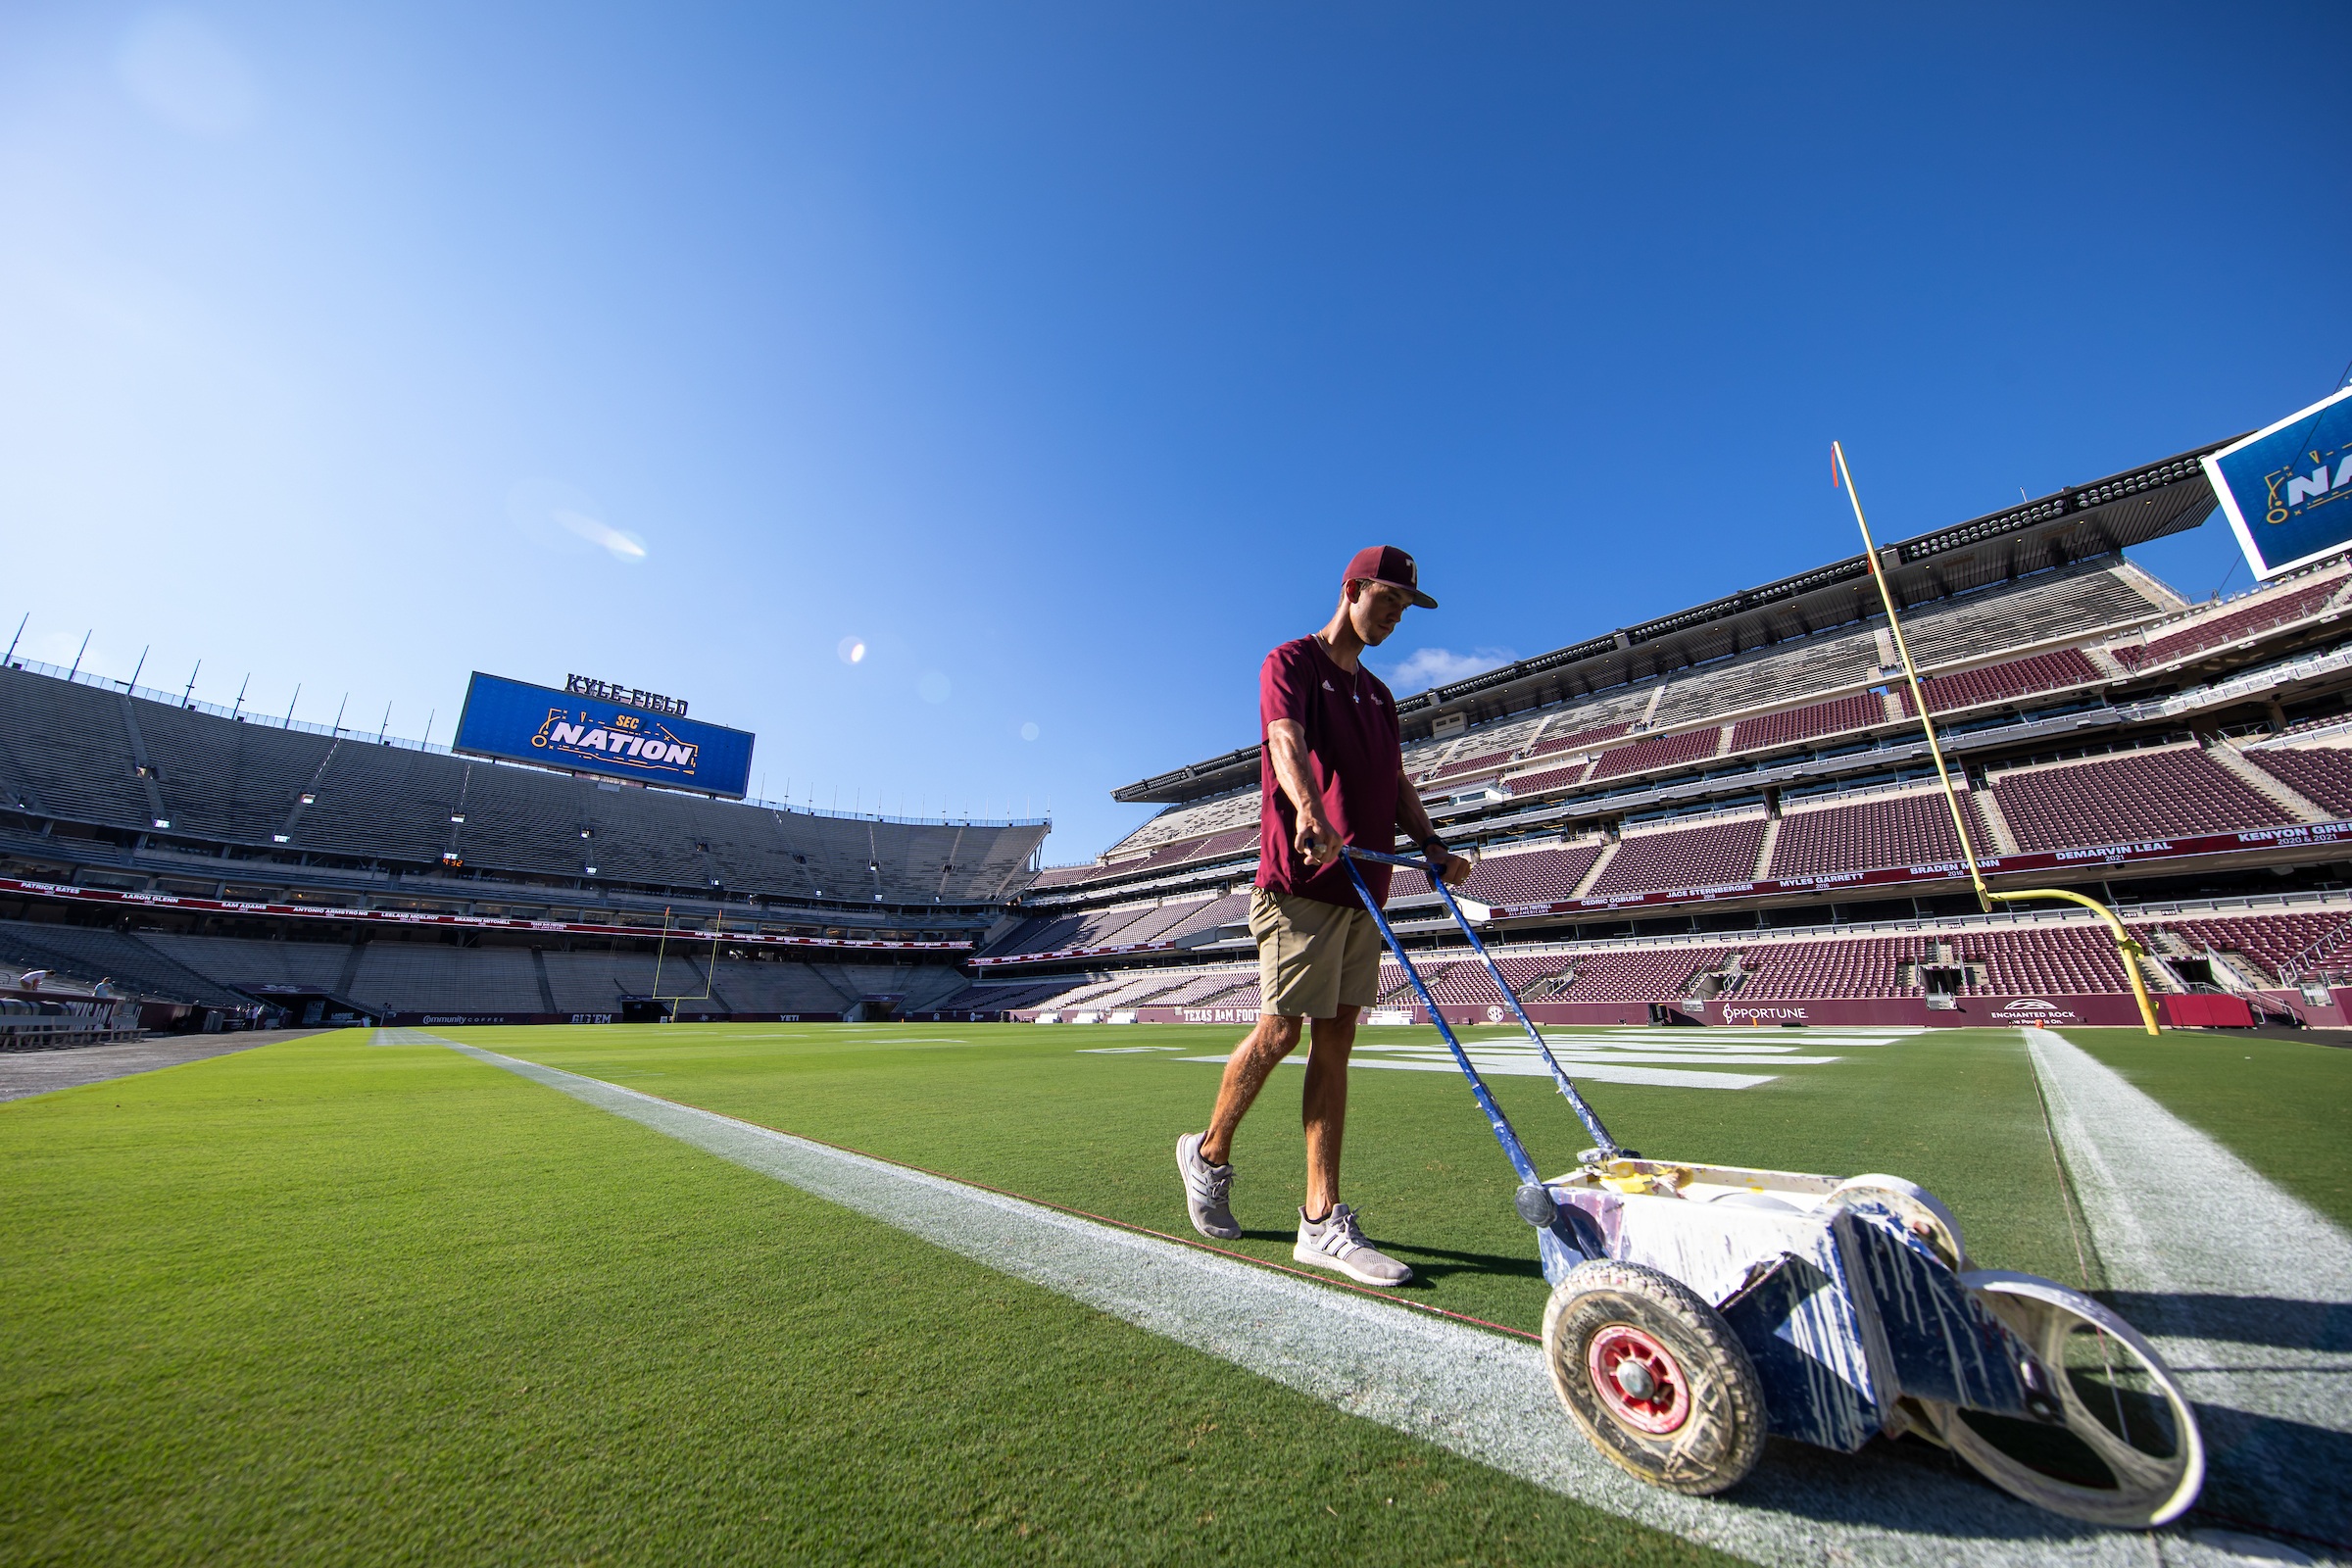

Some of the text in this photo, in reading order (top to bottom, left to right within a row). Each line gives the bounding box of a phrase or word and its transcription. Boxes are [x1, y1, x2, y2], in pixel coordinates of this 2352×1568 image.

[564, 673, 689, 718] KYLE FIELD
[615, 714, 640, 730] SEC
[550, 721, 693, 765] NATION
[2237, 827, 2309, 842] KENYON
[2277, 836, 2299, 845] 2020
[2055, 842, 2173, 860] DEMARVIN LEAL
[1910, 863, 1958, 874] BRADEN
[1780, 873, 1864, 887] MYLES GARRETT
[21, 882, 80, 894] PATRICK BATES
[1690, 884, 1754, 896] STERNBERGER
[1581, 895, 1644, 906] CEDRIC OGBUEHI
[422, 1014, 467, 1025] Community
[1183, 1008, 1213, 1022] TEXAS
[1214, 1008, 1234, 1022] A&M
[1488, 1005, 1504, 1021] SEC
